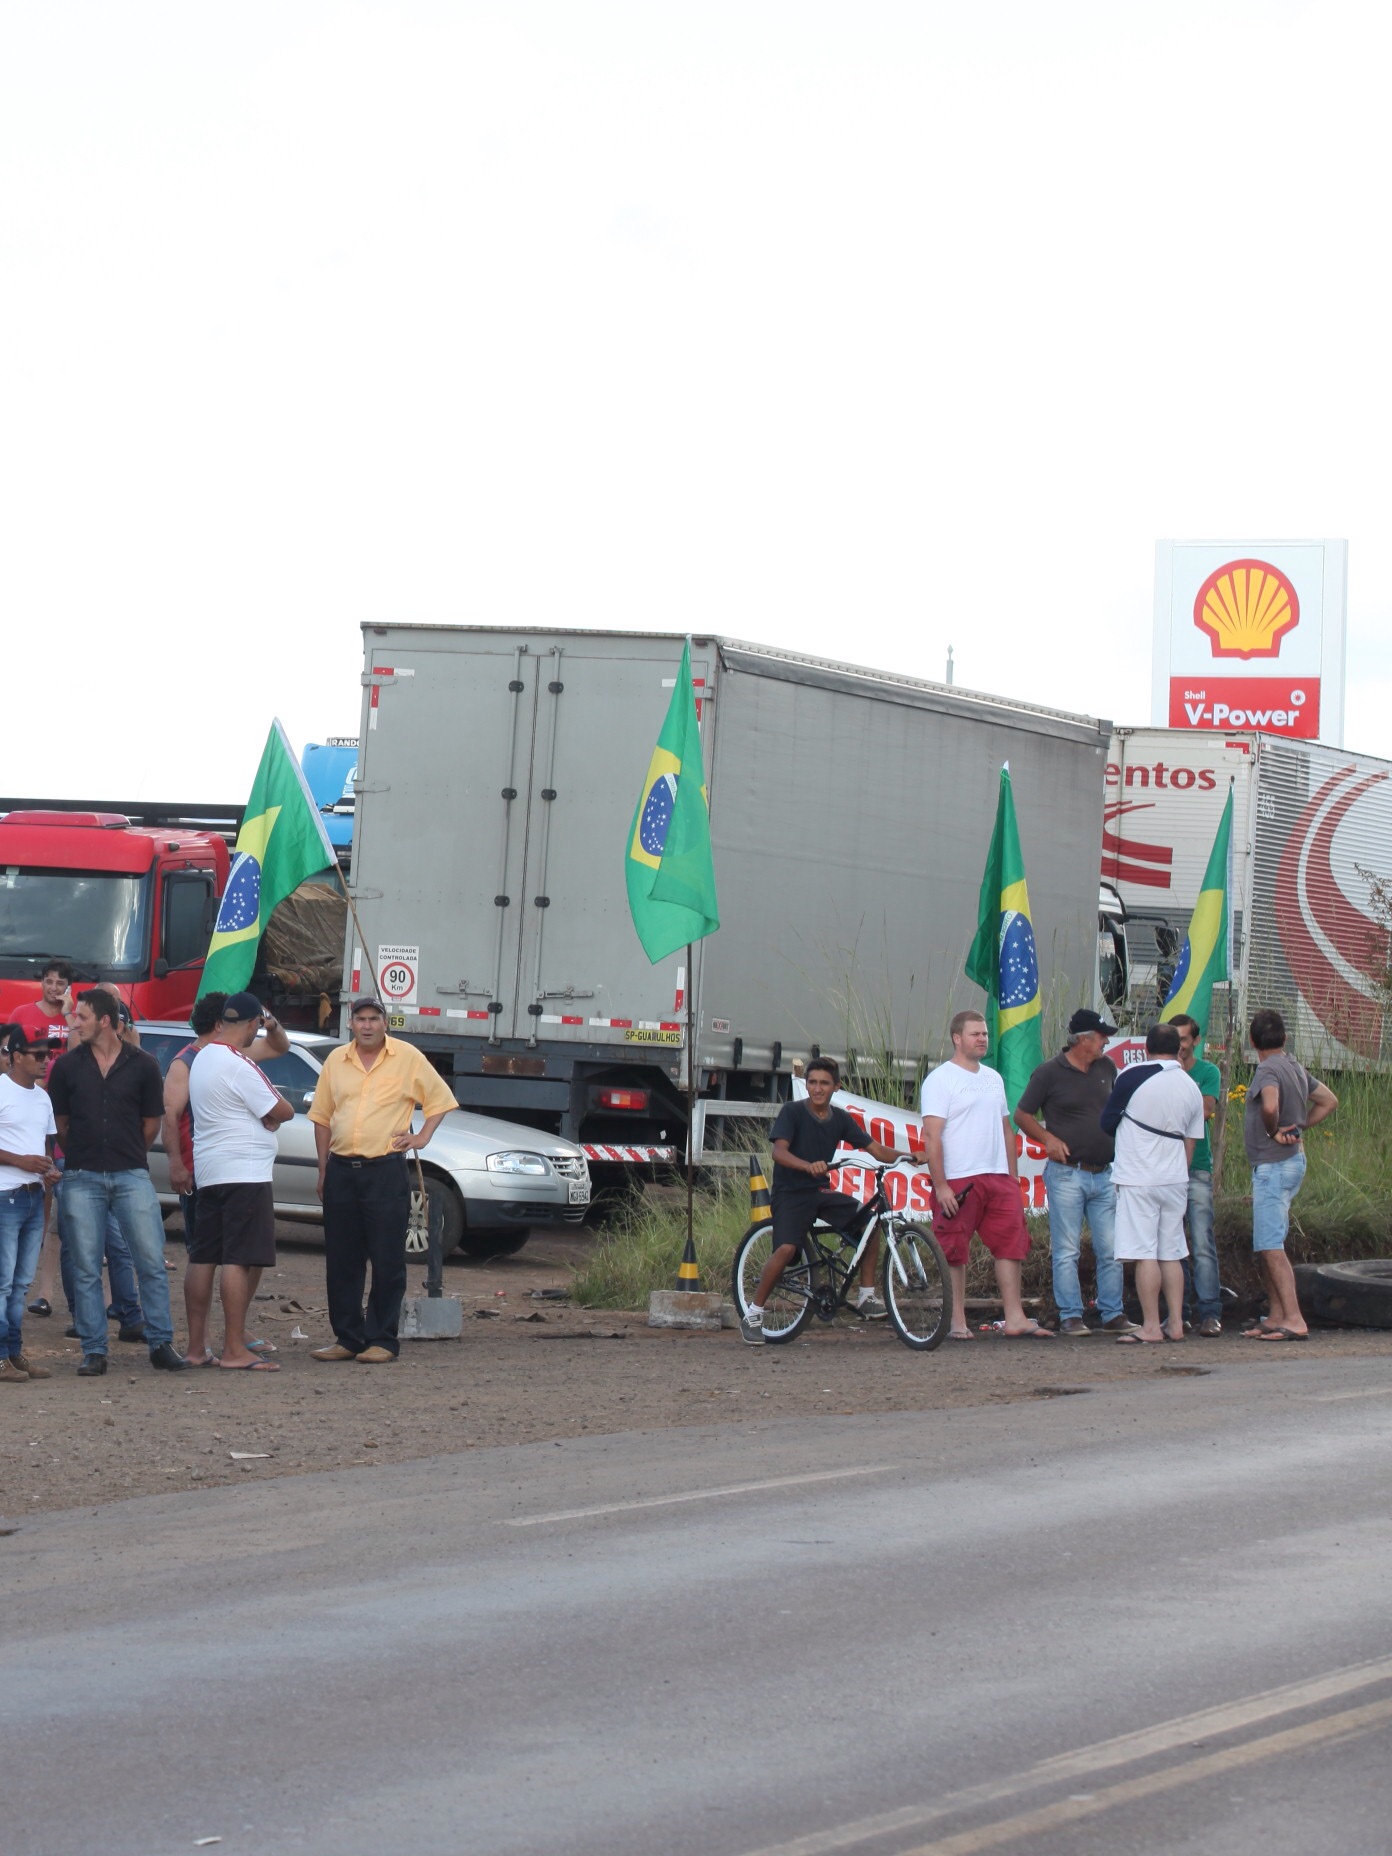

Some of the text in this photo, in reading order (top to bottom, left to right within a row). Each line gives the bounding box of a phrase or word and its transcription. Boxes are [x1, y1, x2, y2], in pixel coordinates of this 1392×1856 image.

[1184, 691, 1206, 700] Shell
[1184, 703, 1300, 727] V-Power
[389, 970, 406, 983] 90
[390, 1016, 405, 1027] 69
[625, 1030, 681, 1042] SP-GUARULHOS
